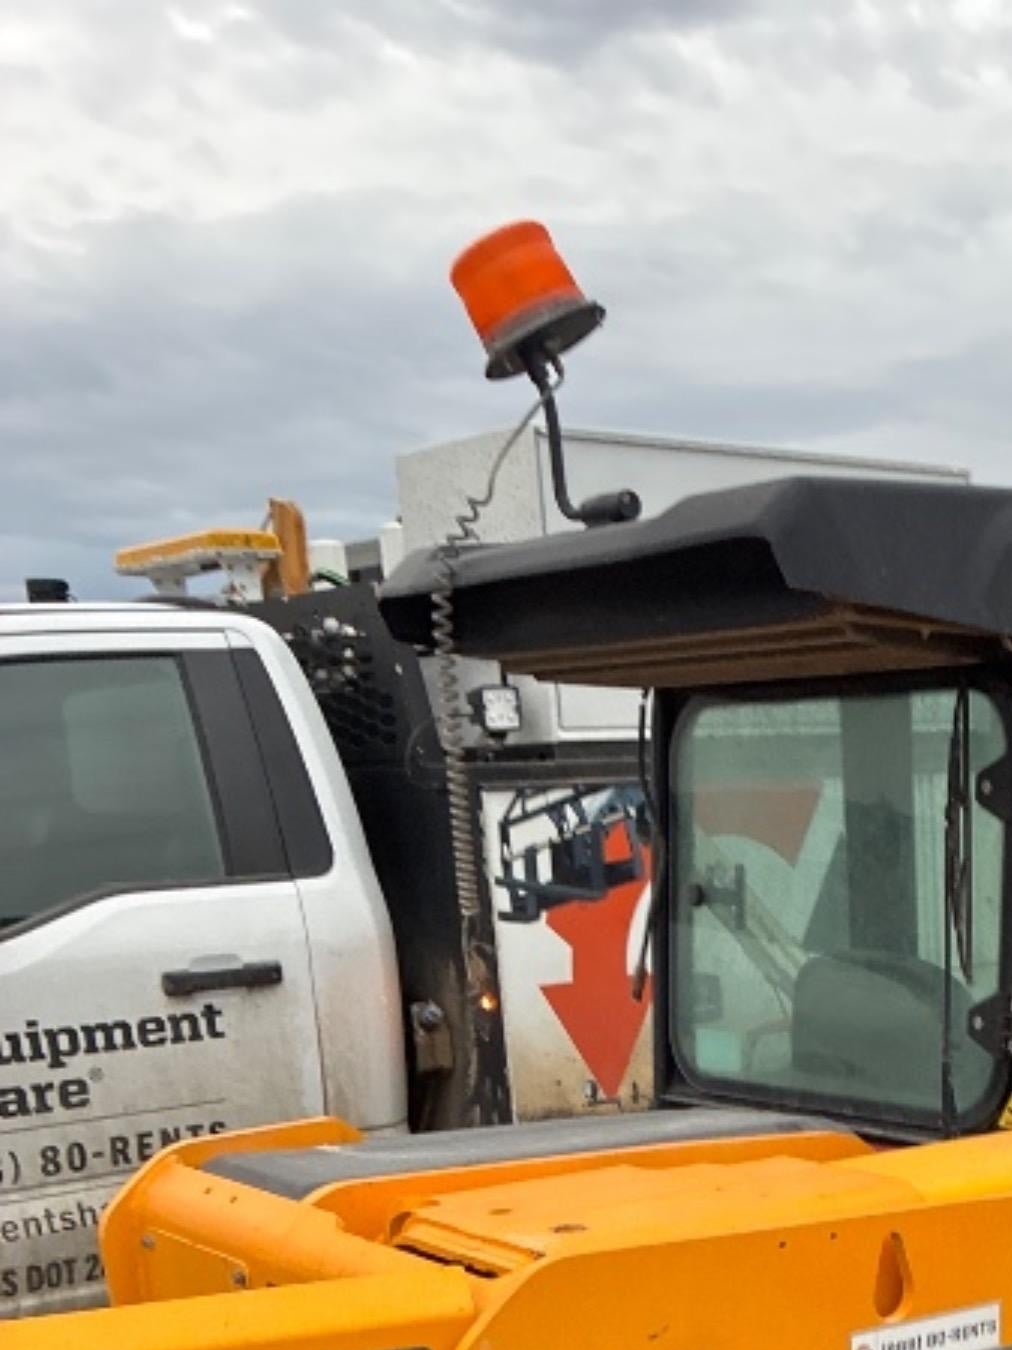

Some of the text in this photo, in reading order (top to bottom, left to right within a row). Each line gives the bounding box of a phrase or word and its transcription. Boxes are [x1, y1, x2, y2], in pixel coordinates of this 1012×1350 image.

[0, 1003, 225, 1068] uipment
[1, 1201, 108, 1242] entsh
[26, 1258, 77, 1293] DOT
[85, 1253, 105, 1282] 2
